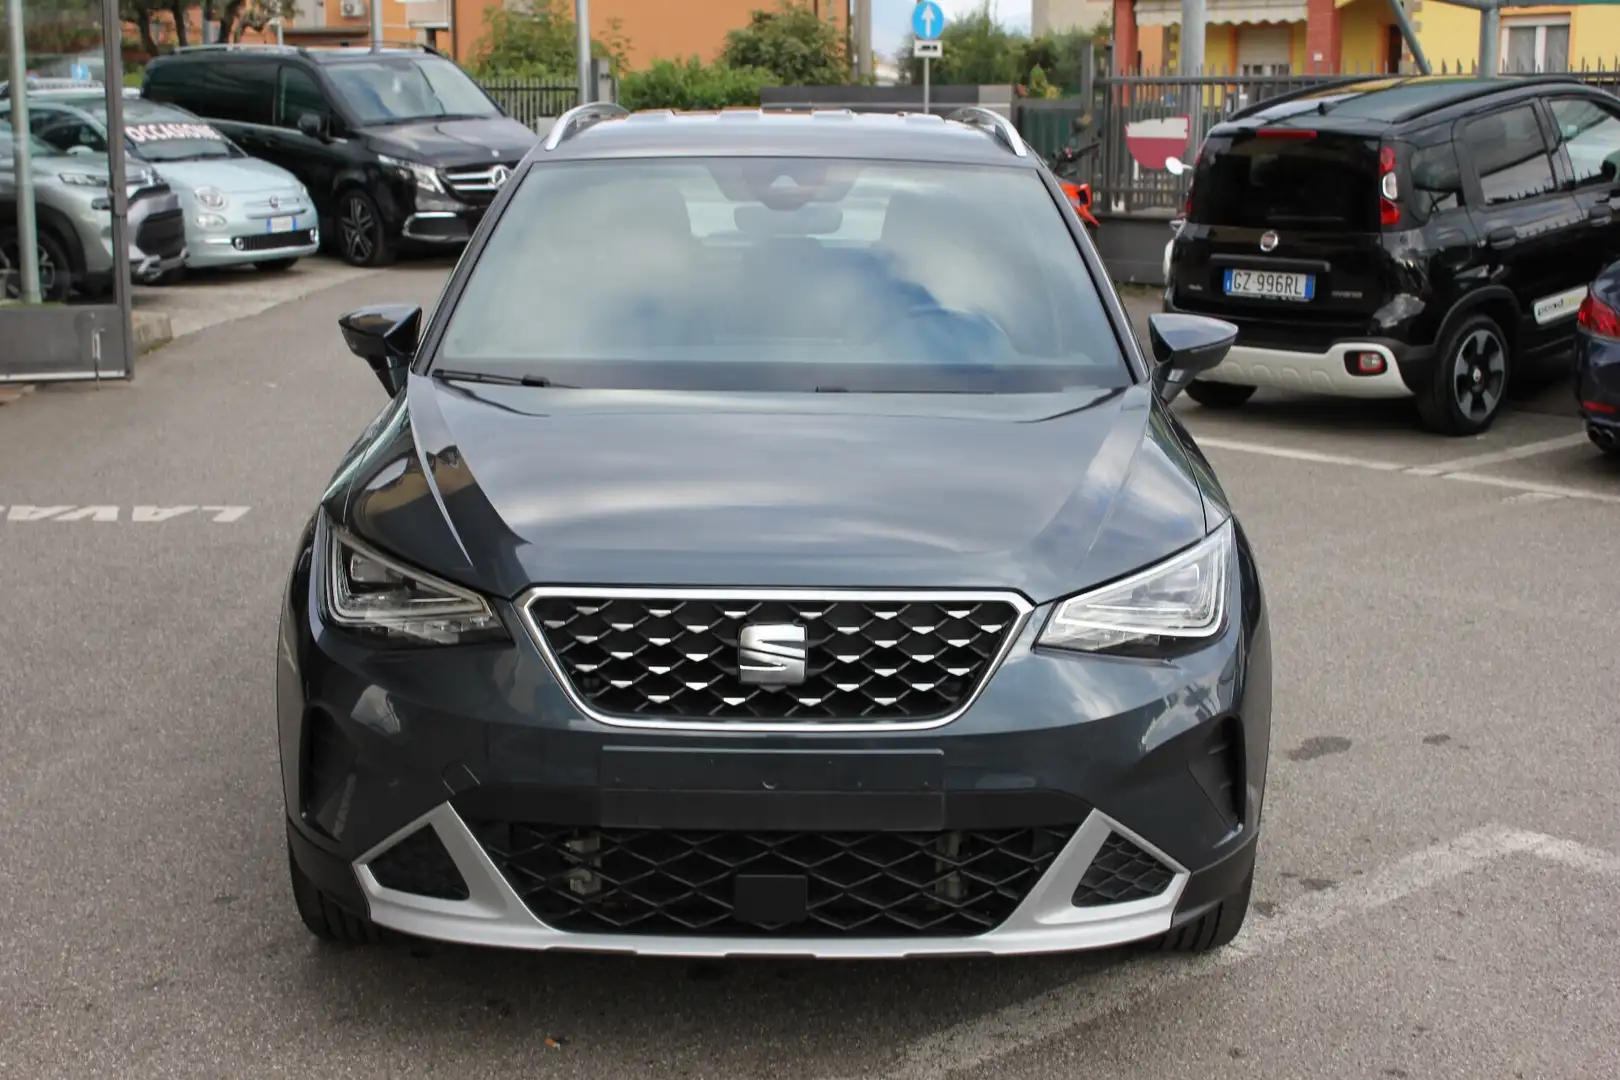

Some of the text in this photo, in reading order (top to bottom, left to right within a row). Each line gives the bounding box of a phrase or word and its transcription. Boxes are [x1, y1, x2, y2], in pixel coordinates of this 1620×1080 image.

[1233, 272, 1302, 295] GZ 996RL
[0, 504, 251, 522] LAVA
